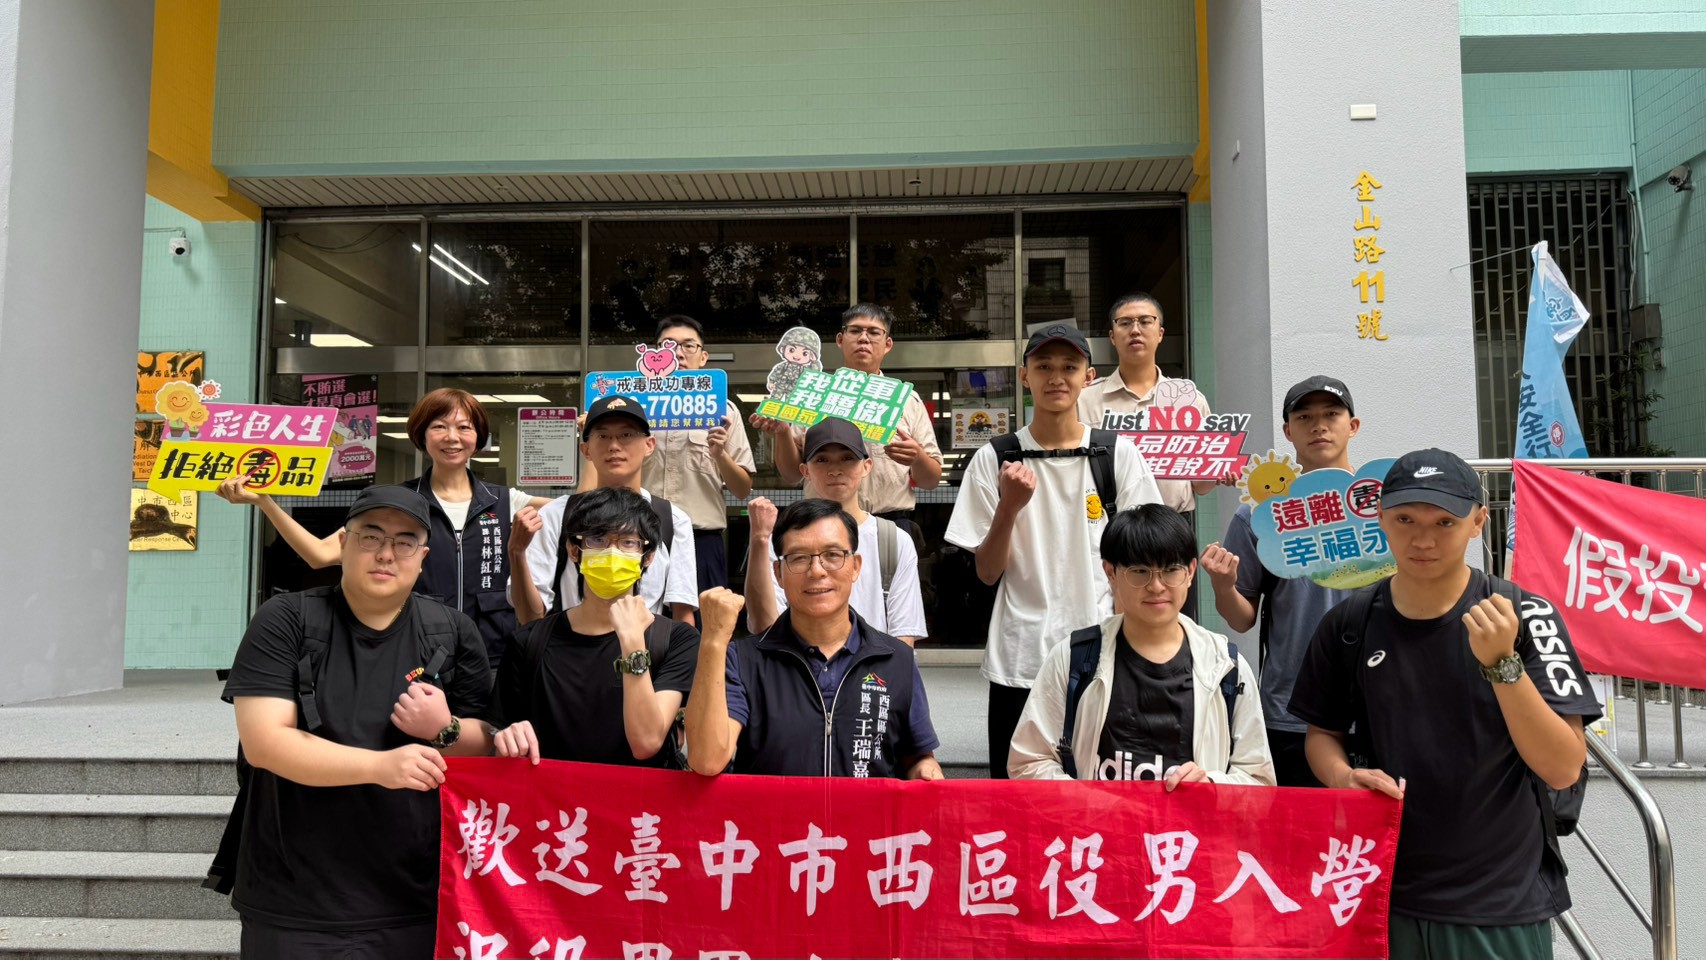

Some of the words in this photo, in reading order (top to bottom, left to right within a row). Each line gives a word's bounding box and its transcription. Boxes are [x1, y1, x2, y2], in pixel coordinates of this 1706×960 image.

[1351, 169, 1388, 340] 金山路11號
[303, 379, 346, 397] 不賄選
[616, 375, 712, 393] 戒毒成功專線
[800, 369, 911, 404] 我從軍!
[788, 388, 899, 427] 我驕傲!
[1102, 409, 1144, 430] just
[1148, 405, 1202, 431] NO
[1204, 413, 1249, 436] say
[209, 410, 328, 441] 彩色人生
[1418, 466, 1438, 474] NIKE
[1563, 526, 1706, 634] 假投
[1528, 619, 1583, 697] asics
[860, 692, 872, 714] 區長
[874, 693, 890, 760] 西區區公所
[457, 798, 1382, 927] 歡送臺中市西區役男入營
